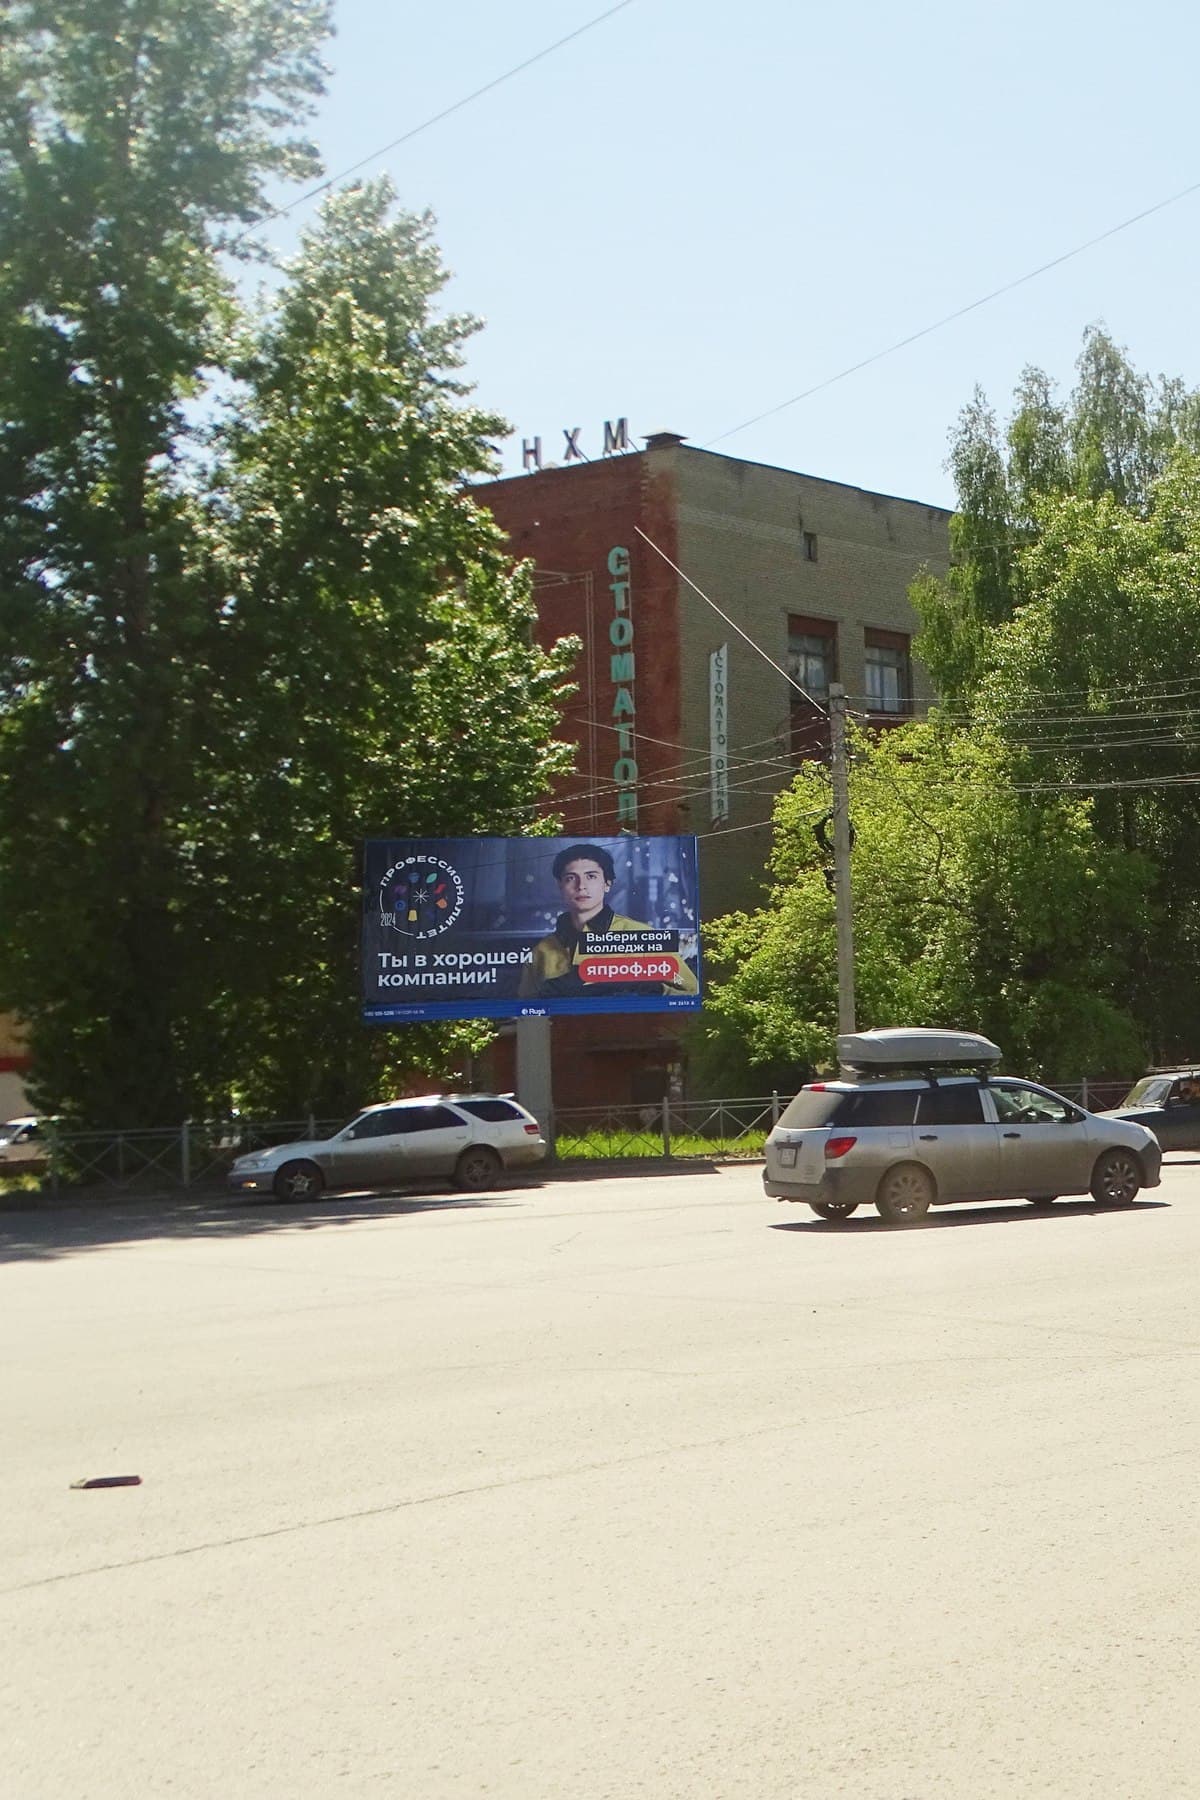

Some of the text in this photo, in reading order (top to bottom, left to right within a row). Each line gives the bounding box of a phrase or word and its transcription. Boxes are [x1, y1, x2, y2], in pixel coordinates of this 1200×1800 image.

[607, 546, 637, 836] СТОМАТОЛ
[380, 855, 464, 939] ПРОФЕССИОНАЛИТЕТ
[380, 912, 396, 927] 2024
[586, 930, 671, 943] Выбери свой
[586, 943, 663, 953] колледж на
[378, 947, 533, 969] Ты в хорошей
[378, 967, 497, 987] компании!
[587, 960, 671, 978] япроф.рф
